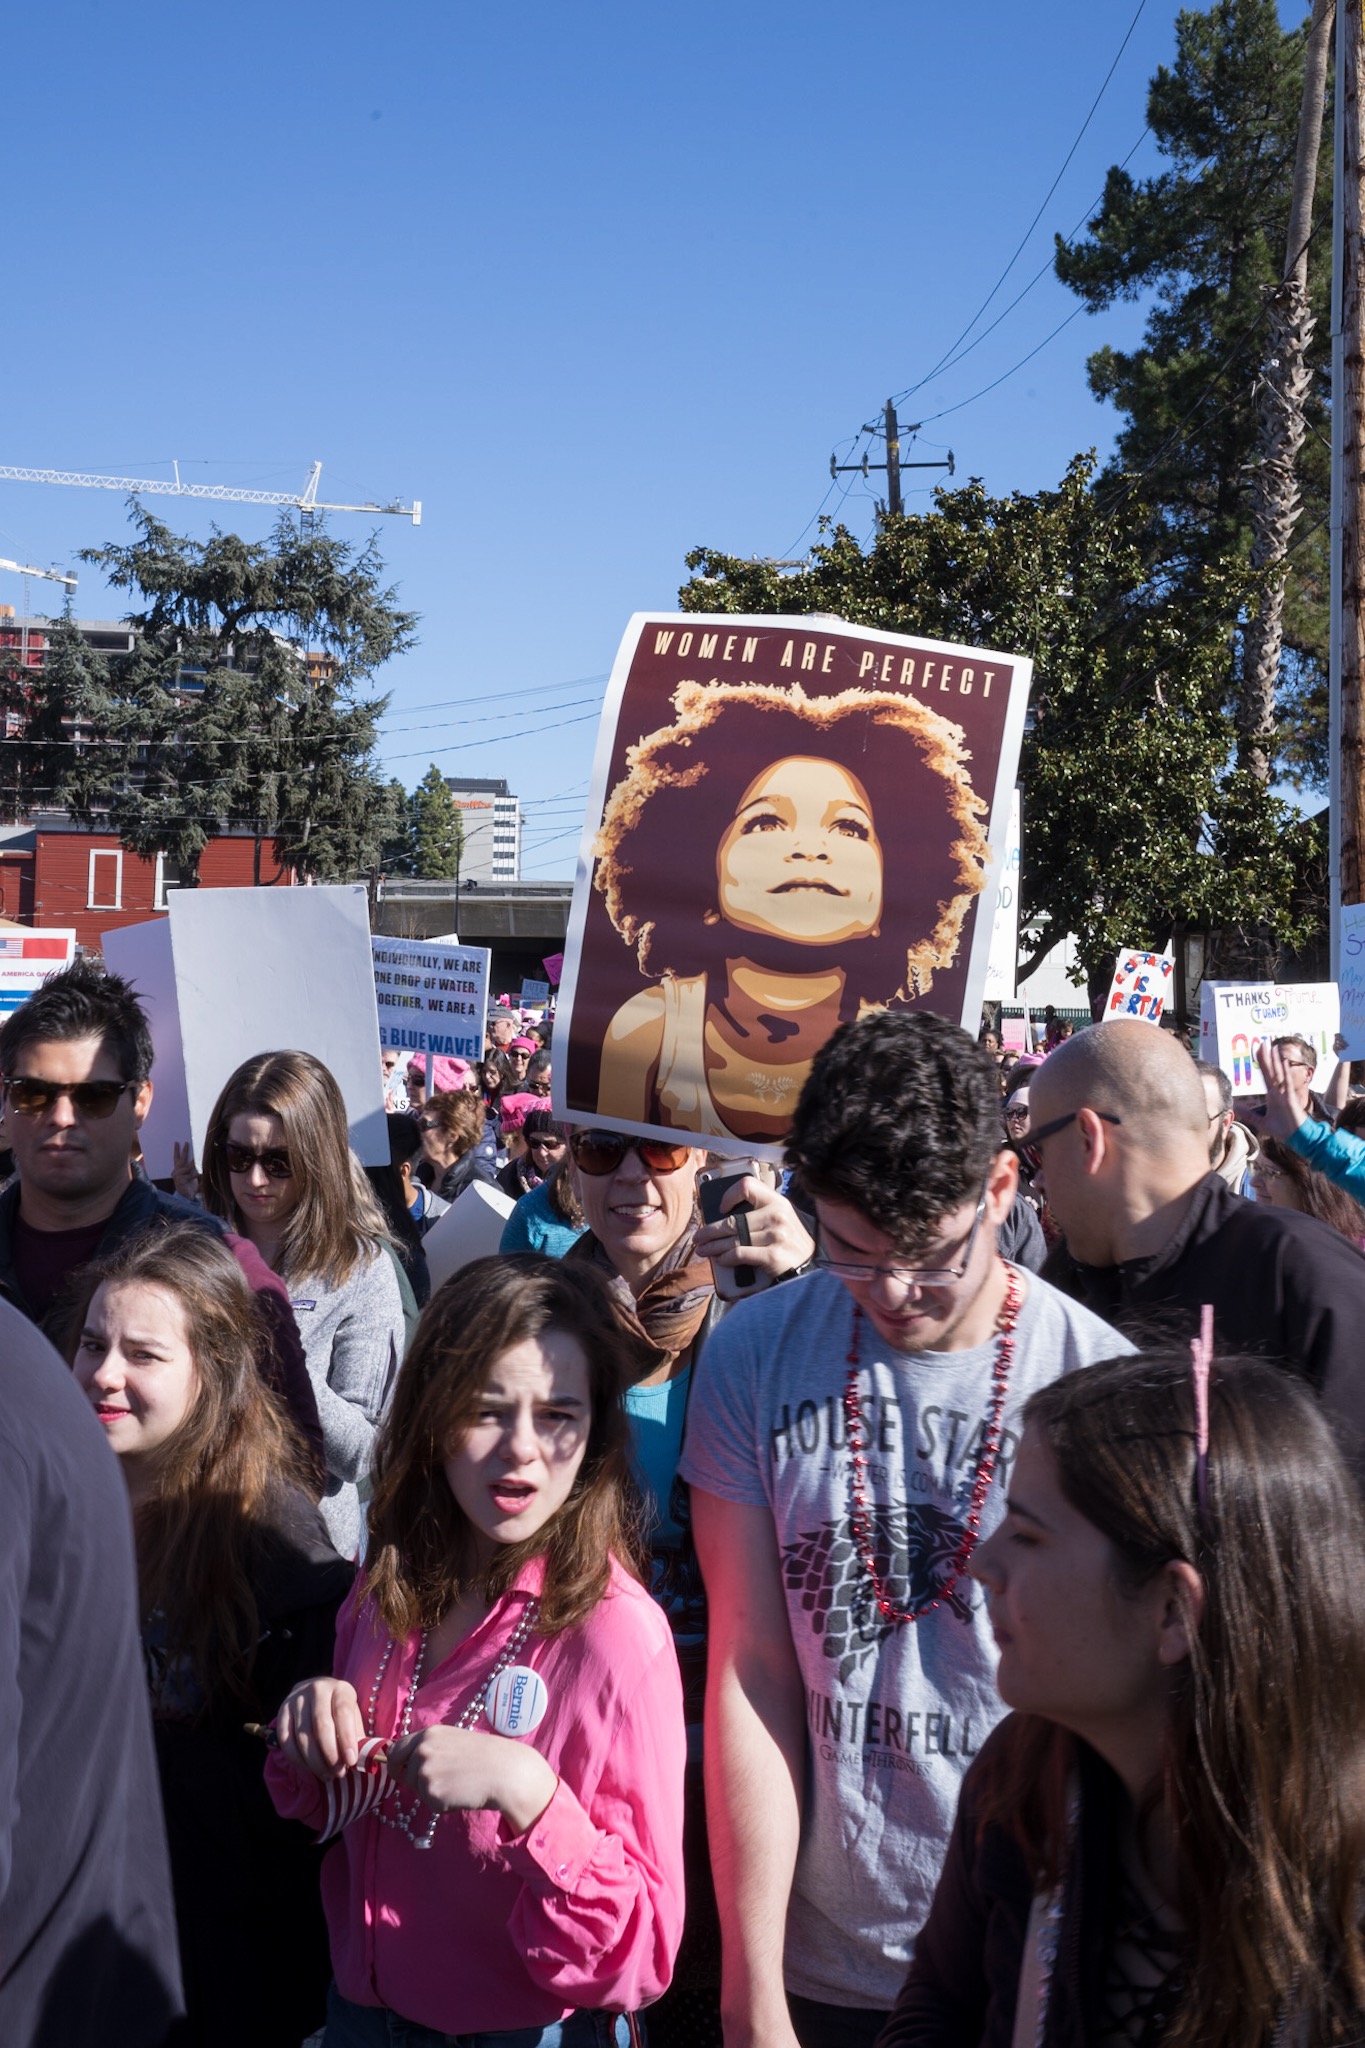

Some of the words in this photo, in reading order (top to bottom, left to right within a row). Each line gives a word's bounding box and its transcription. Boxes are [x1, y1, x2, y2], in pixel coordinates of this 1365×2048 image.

[654, 630, 759, 664] WOMEN
[780, 640, 837, 673] ARE
[859, 650, 996, 698] PERFECT
[443, 957, 459, 971] WE
[461, 960, 482, 973] ARE
[374, 971, 392, 984] ONE
[394, 973, 422, 988] DROP
[423, 977, 437, 989] OF
[438, 979, 478, 994] WATER.
[1133, 976, 1150, 992] IS
[376, 990, 424, 1010] OGETHER,
[428, 998, 444, 1012] WE
[446, 1000, 466, 1014] ARE
[468, 1002, 476, 1015] A
[1110, 991, 1164, 1021] FERTILE
[1220, 992, 1271, 1008] THANKS
[1254, 1006, 1287, 1020] TURNED
[390, 1027, 427, 1050] BLUE
[427, 1034, 481, 1058] WAVE!
[773, 1394, 899, 1462] HOUSE
[917, 1404, 1020, 1490] STAR
[508, 1674, 529, 1729] Bernie
[819, 1744, 862, 1765] GAME
[870, 1750, 934, 1776] THRONES
